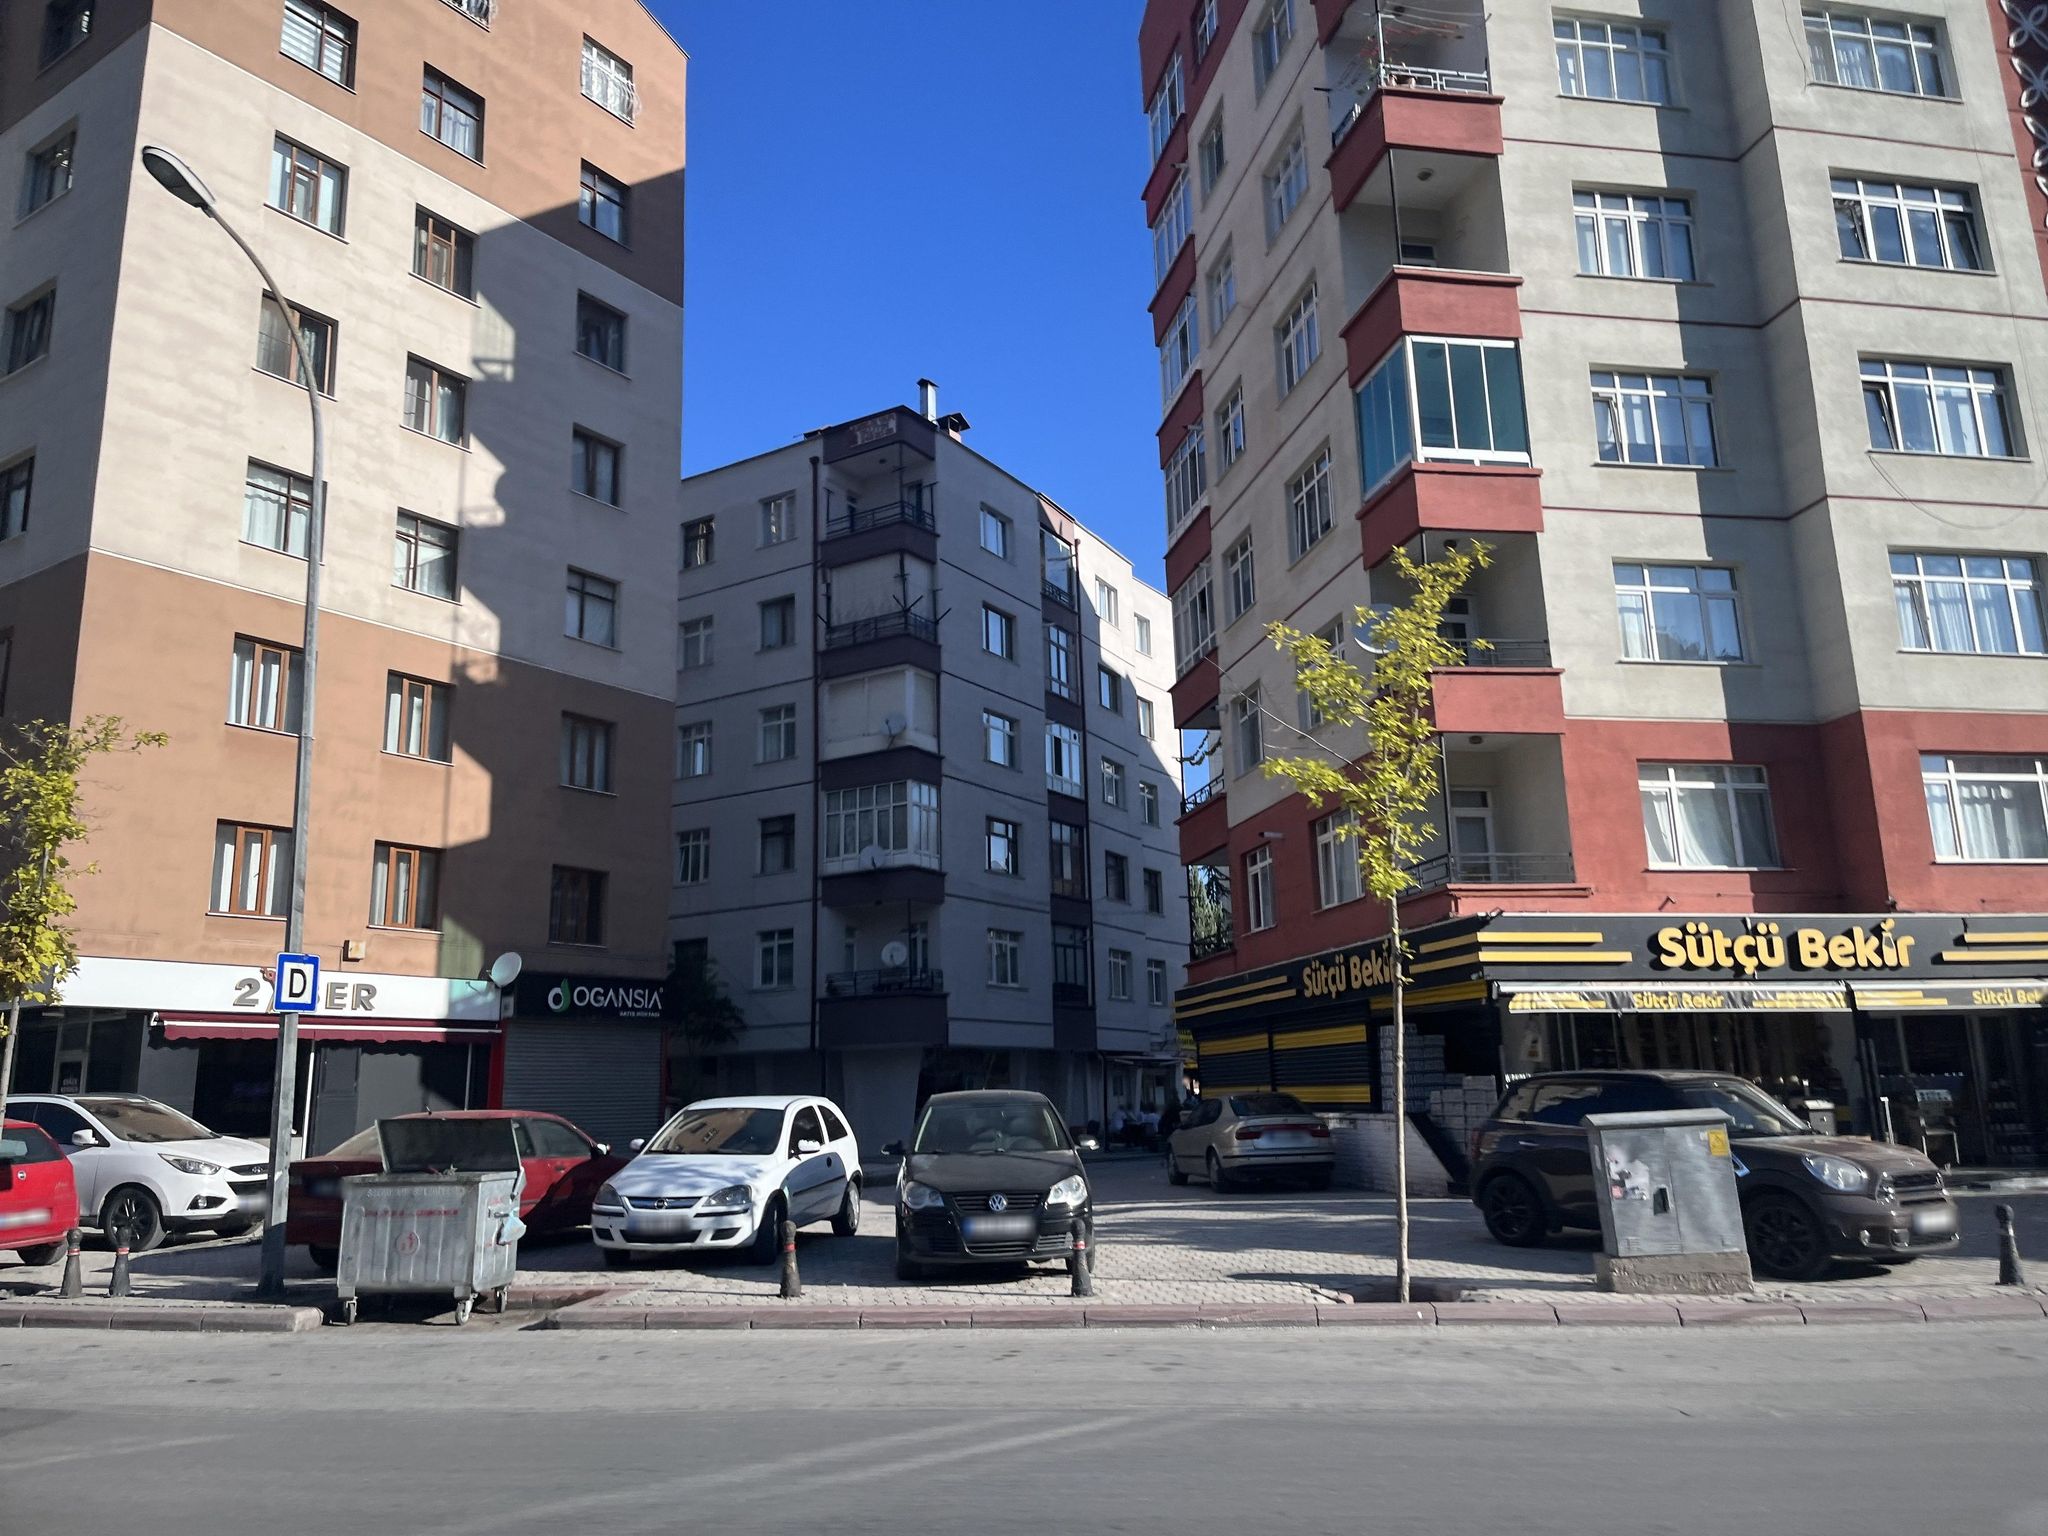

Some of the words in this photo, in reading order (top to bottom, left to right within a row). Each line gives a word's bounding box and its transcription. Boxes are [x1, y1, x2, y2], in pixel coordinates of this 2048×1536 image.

[1657, 921, 1786, 975] Sütçü
[1797, 918, 1916, 968] Bekir
[289, 968, 307, 998] D
[1303, 953, 1347, 999] Sütçü
[1632, 990, 1678, 1010] Sütçü
[1972, 988, 2014, 1007] Sütçü
